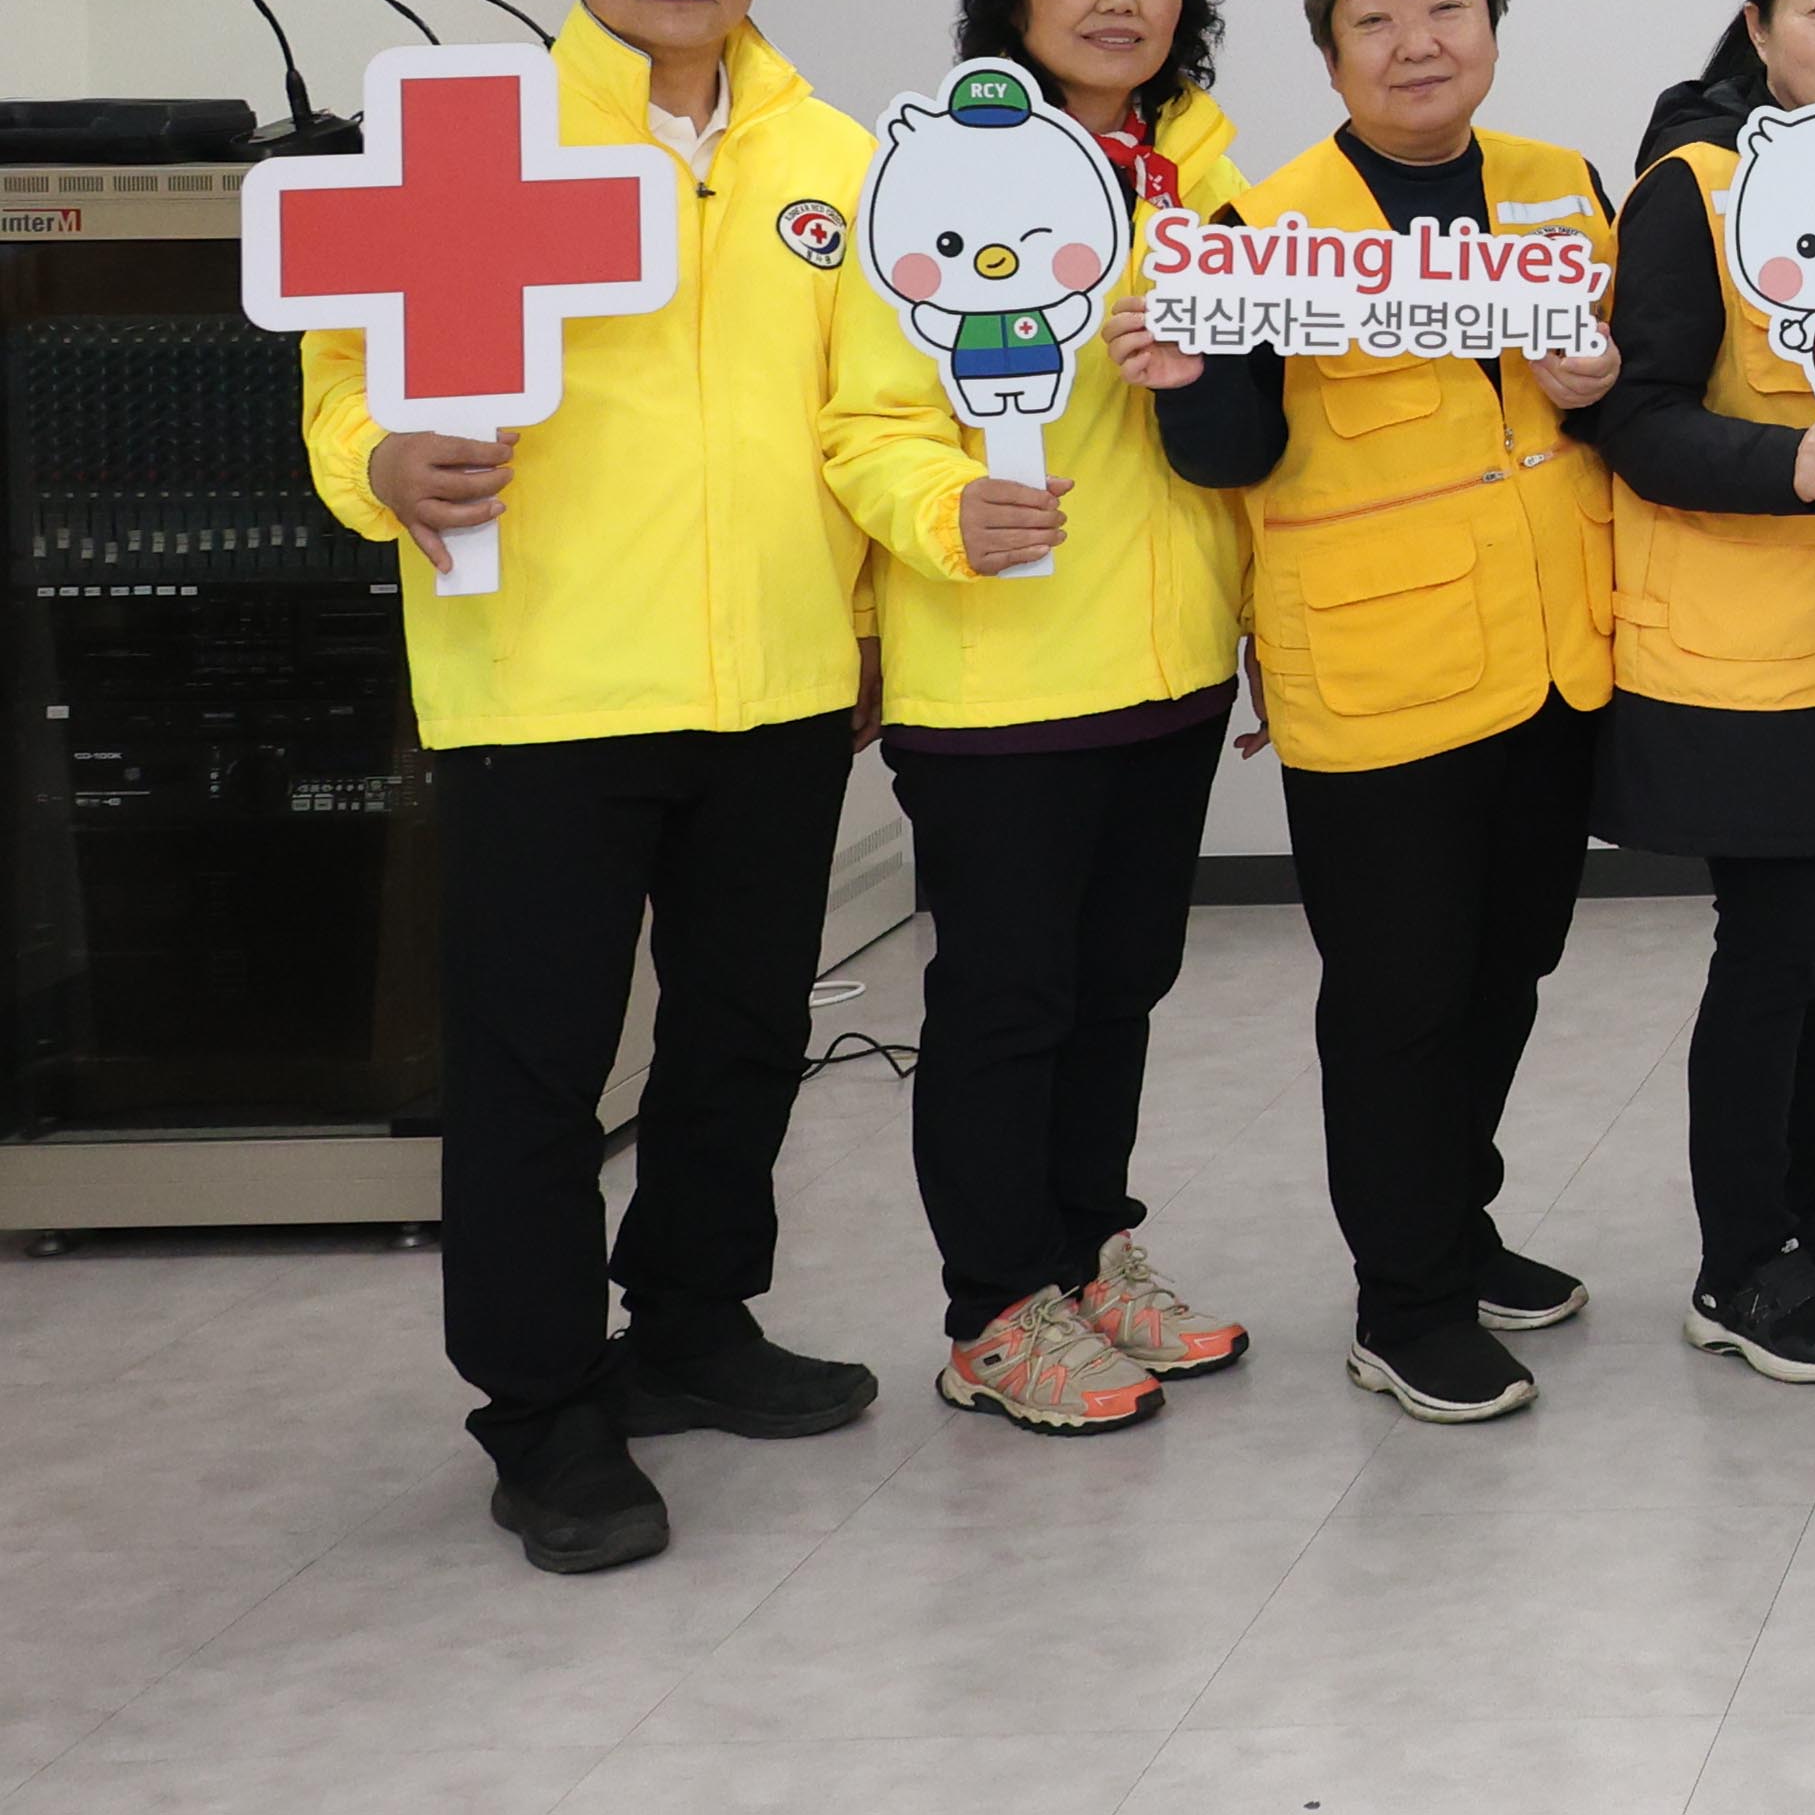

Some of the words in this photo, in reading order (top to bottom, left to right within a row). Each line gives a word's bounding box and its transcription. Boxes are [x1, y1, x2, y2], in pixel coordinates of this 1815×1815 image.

[970, 82, 1008, 100] RCY
[1152, 216, 1394, 294] Saving
[1419, 224, 1603, 294] Lives,
[1153, 296, 1346, 349] 적십자는
[1360, 299, 1600, 353] 생명입니다.
